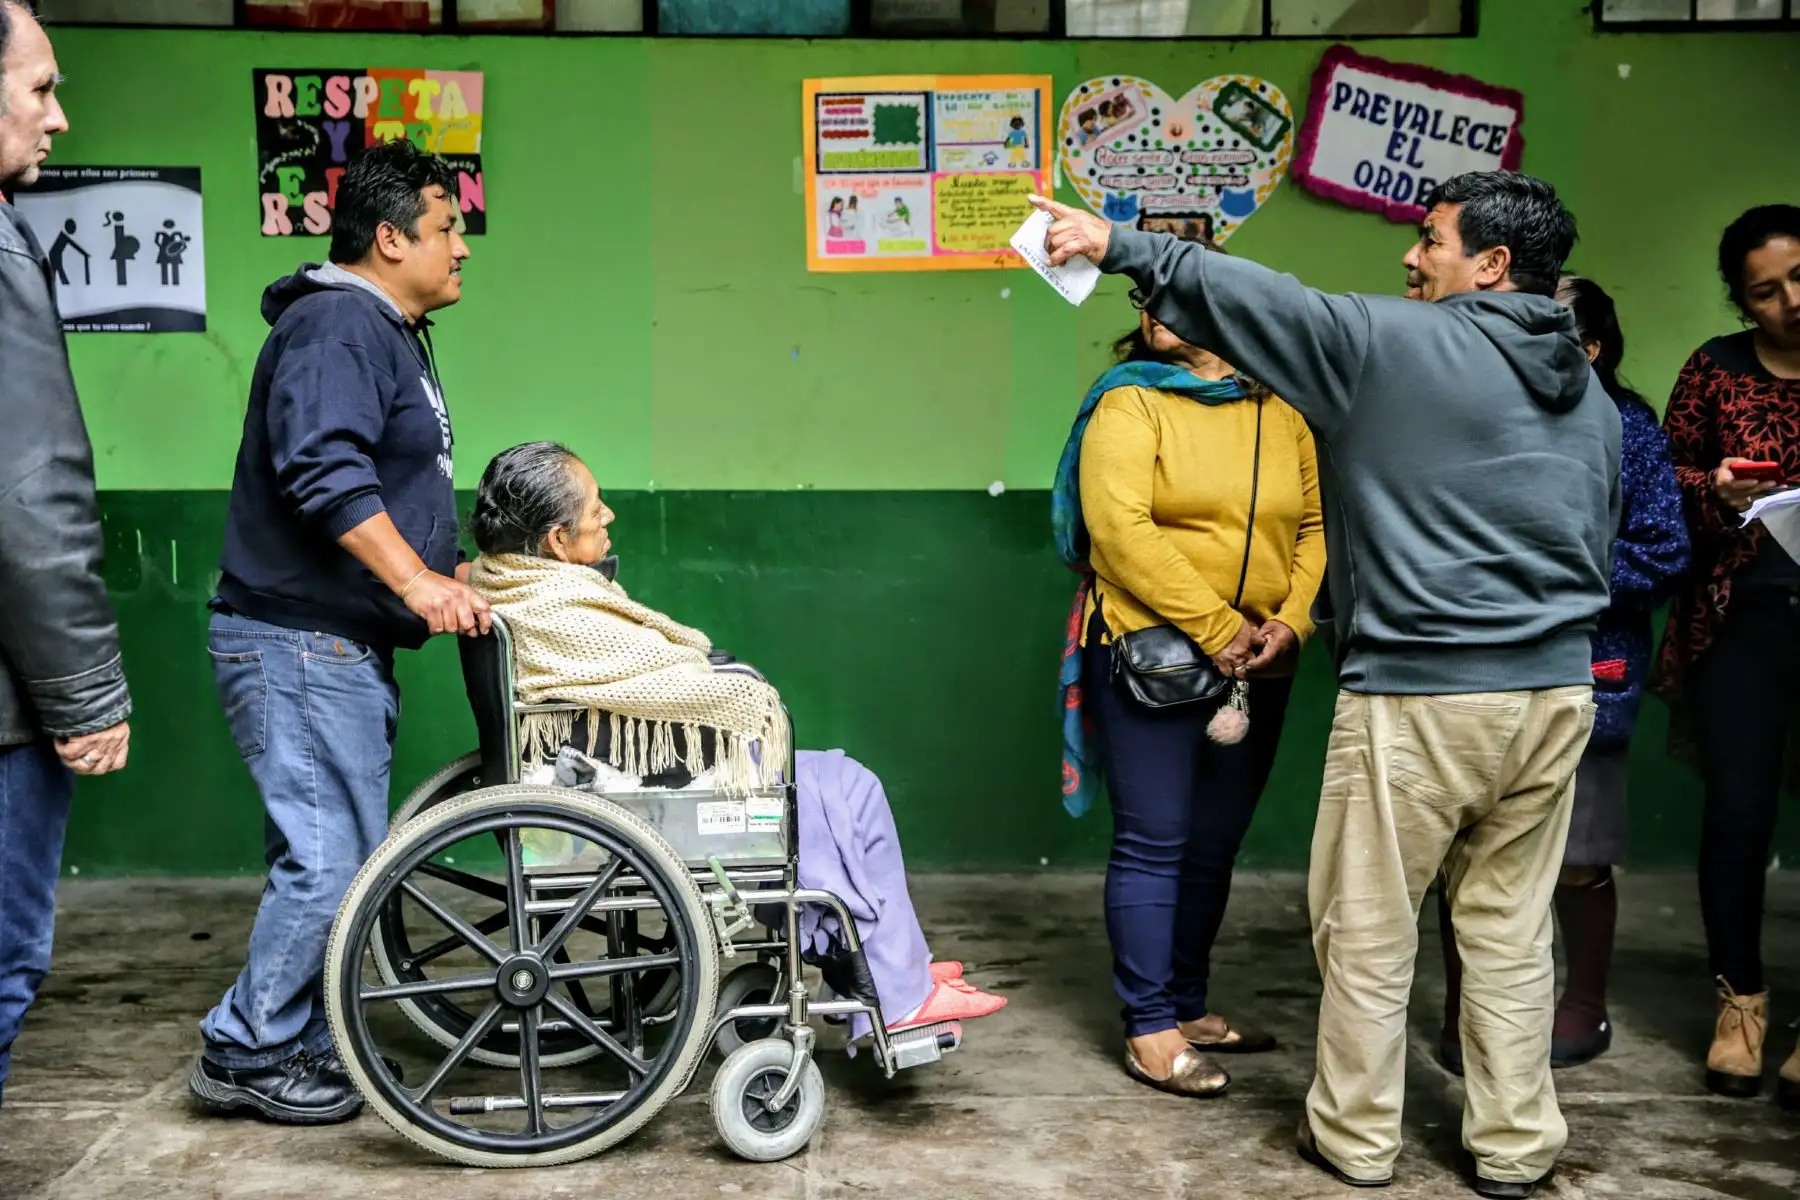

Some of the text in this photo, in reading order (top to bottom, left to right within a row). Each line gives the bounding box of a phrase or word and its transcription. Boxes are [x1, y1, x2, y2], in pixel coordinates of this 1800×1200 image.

[264, 74, 470, 120] RESPETA
[1332, 81, 1508, 156] PREVALECE
[322, 120, 351, 162] Y
[1386, 129, 1425, 170] EL
[1353, 160, 1439, 206] ORDE
